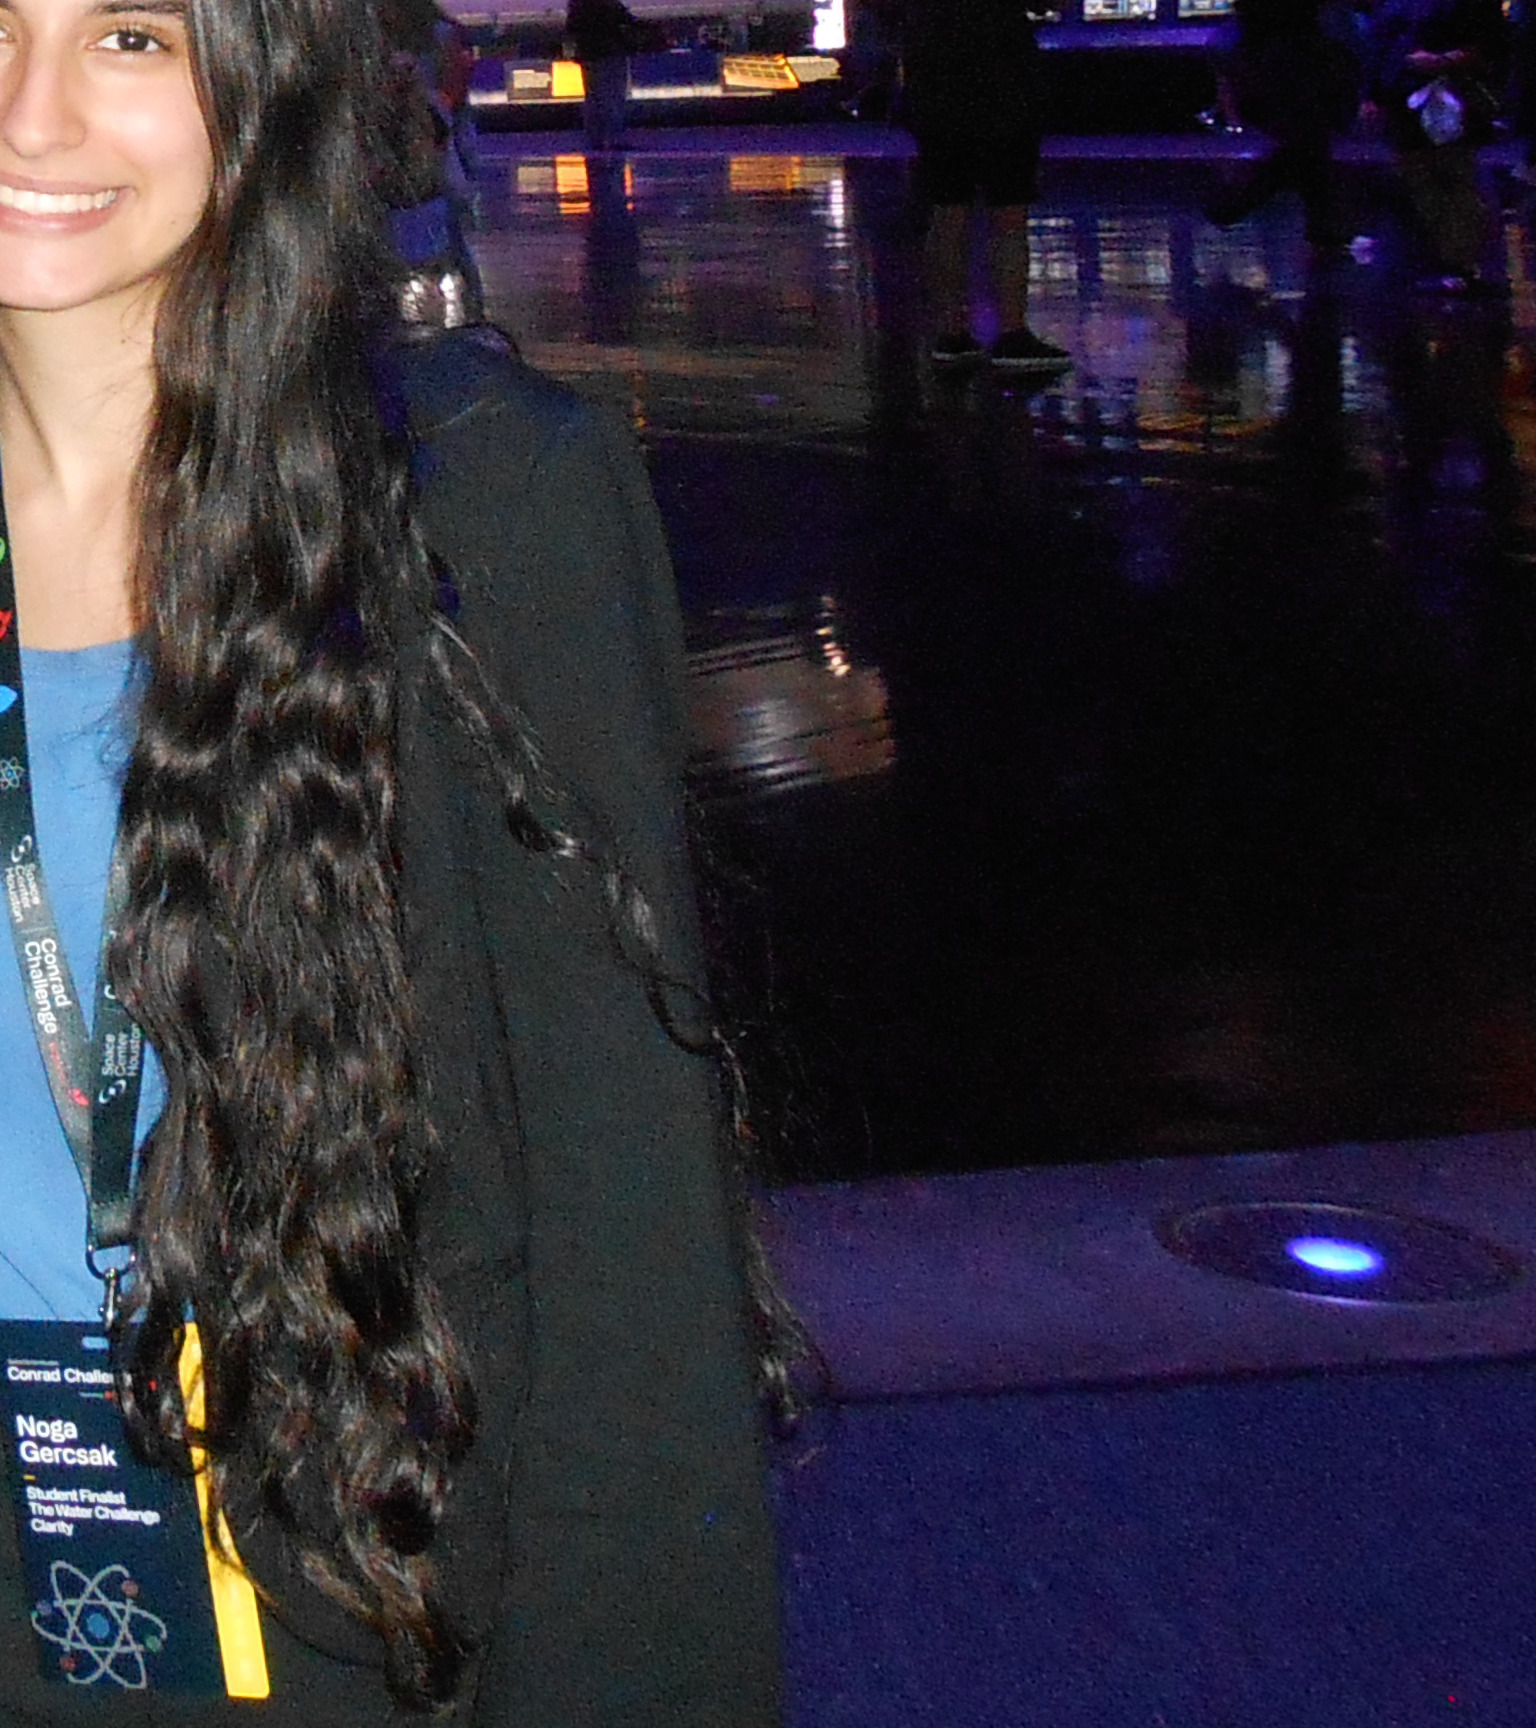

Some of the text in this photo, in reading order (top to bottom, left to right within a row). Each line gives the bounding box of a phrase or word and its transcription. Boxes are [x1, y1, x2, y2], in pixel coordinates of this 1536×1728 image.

[5, 867, 24, 923] Houston
[15, 865, 30, 909] Center
[25, 863, 41, 905] Space
[41, 938, 72, 1007] Conrad
[25, 941, 57, 1034] Challenge
[7, 1366, 61, 1383] Conrad
[15, 1414, 78, 1443] Noga
[19, 1438, 118, 1467] Gercsak
[26, 1485, 127, 1505] Student Finalist
[28, 1501, 161, 1526] The Water Challenge
[30, 1518, 74, 1537] Clarity
